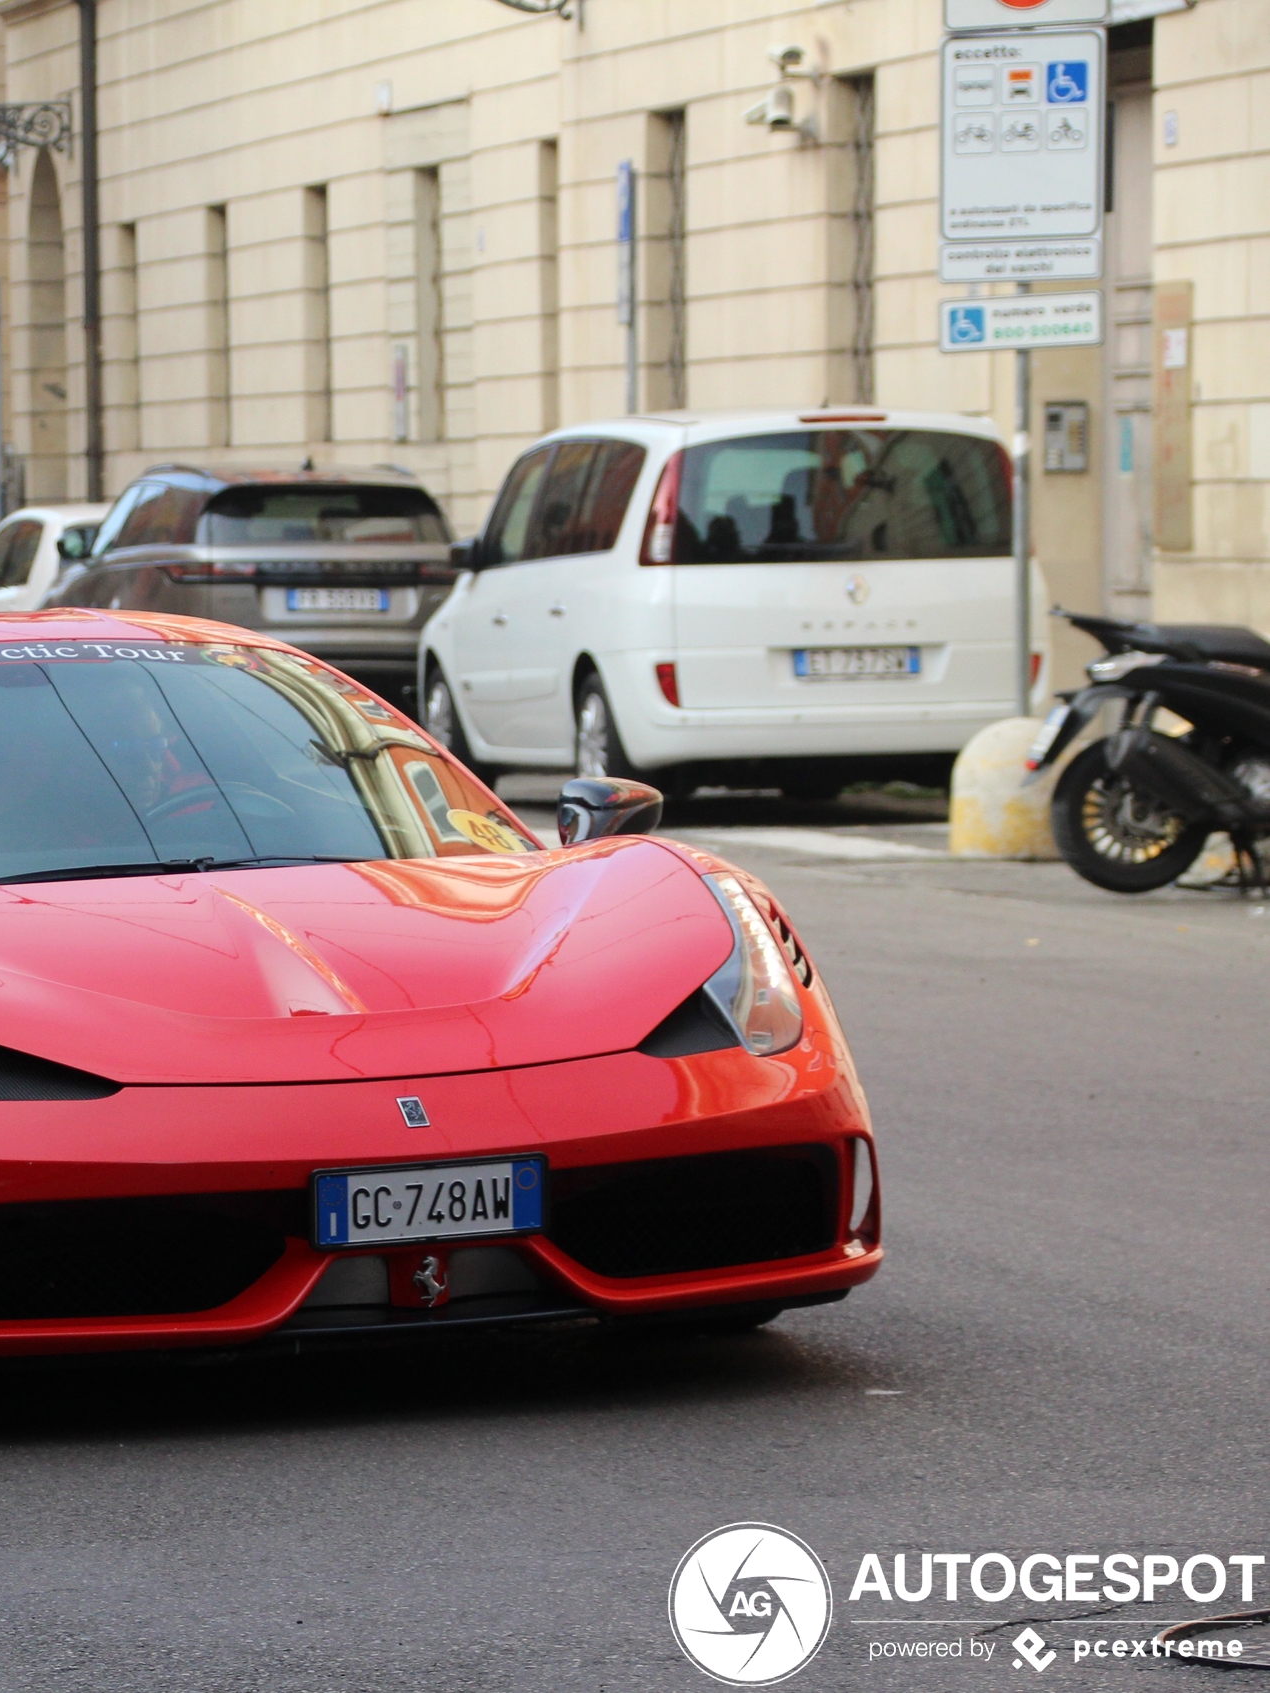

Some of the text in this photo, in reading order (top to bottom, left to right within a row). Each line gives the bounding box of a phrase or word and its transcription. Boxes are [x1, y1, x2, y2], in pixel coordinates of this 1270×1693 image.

[948, 244, 1091, 260] controllo elettronico
[993, 302, 1092, 318] numero verde
[84, 643, 185, 662] Tour
